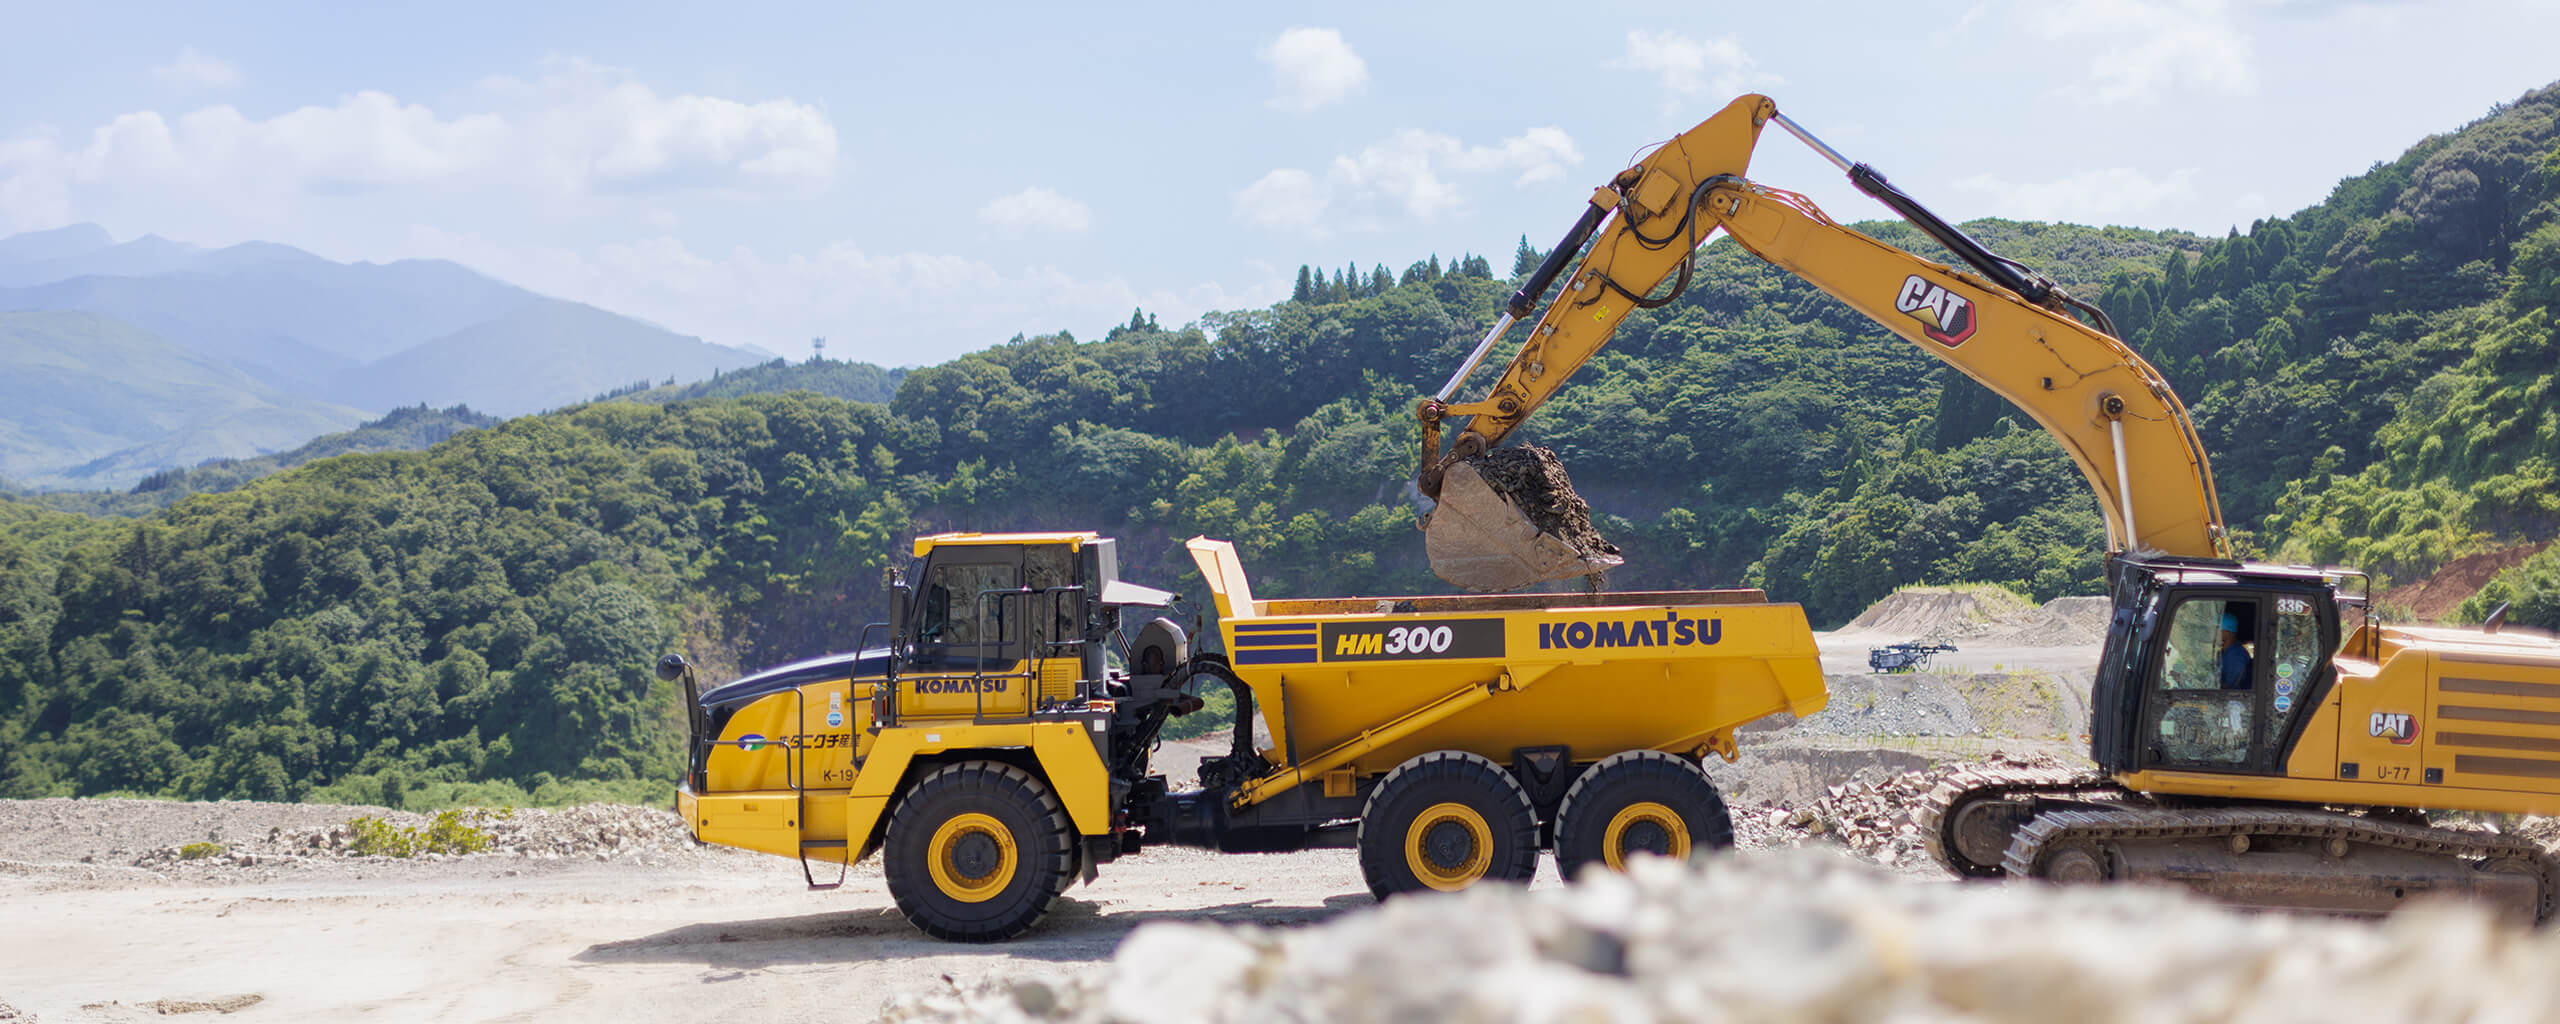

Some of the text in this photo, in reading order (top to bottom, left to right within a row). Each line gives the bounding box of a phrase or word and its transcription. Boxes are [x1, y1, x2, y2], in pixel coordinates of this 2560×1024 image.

[1896, 275, 1967, 332] CAT
[2277, 599, 2304, 613] 336
[1335, 625, 1453, 656] HM300
[1538, 611, 1722, 650] KOMATSU
[914, 679, 1008, 694] KOMATSU
[2369, 712, 2409, 738] CAT
[2377, 765, 2411, 781] U-77
